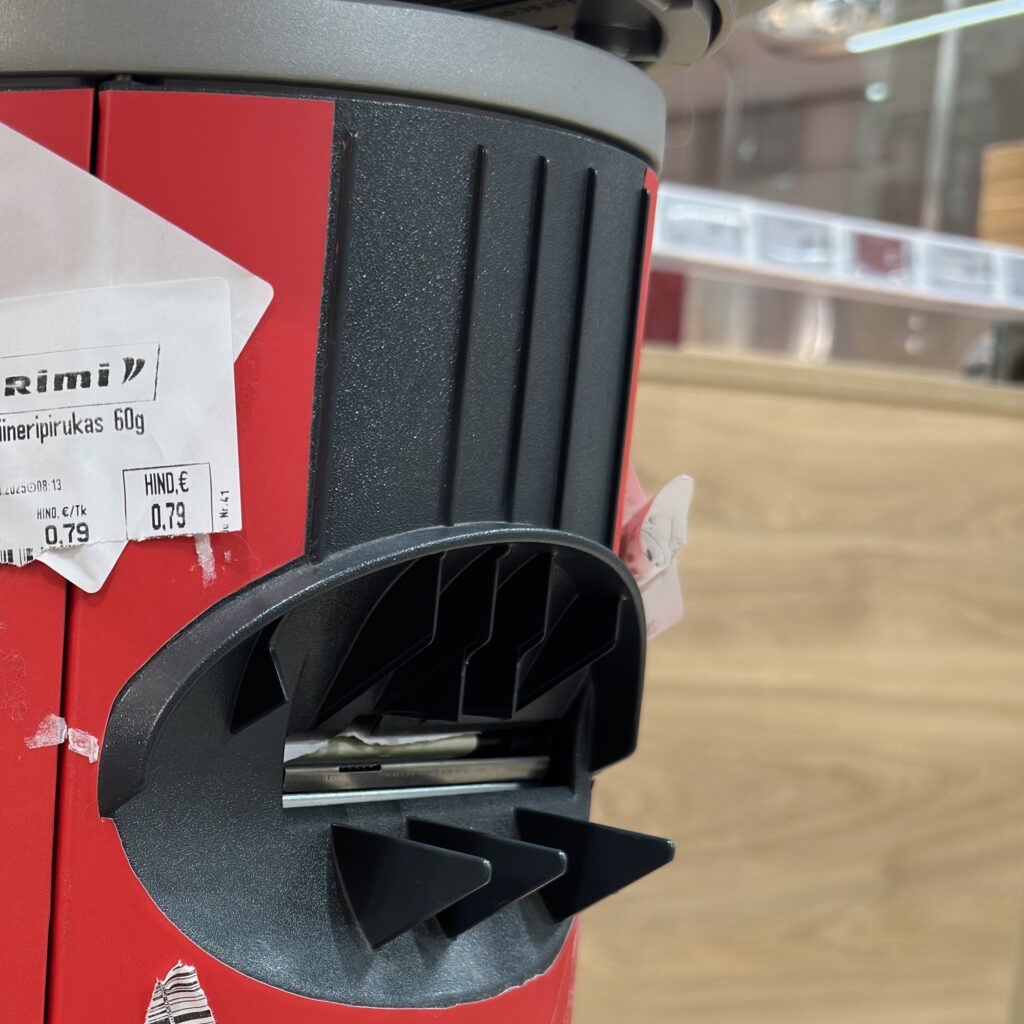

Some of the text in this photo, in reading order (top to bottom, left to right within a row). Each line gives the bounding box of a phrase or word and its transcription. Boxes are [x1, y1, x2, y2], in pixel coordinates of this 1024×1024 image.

[5, 363, 110, 396] Rimi
[114, 407, 145, 435] 60g
[144, 471, 189, 496] HIND,€
[151, 502, 186, 531] 0,79
[44, 522, 90, 546] 0,79
